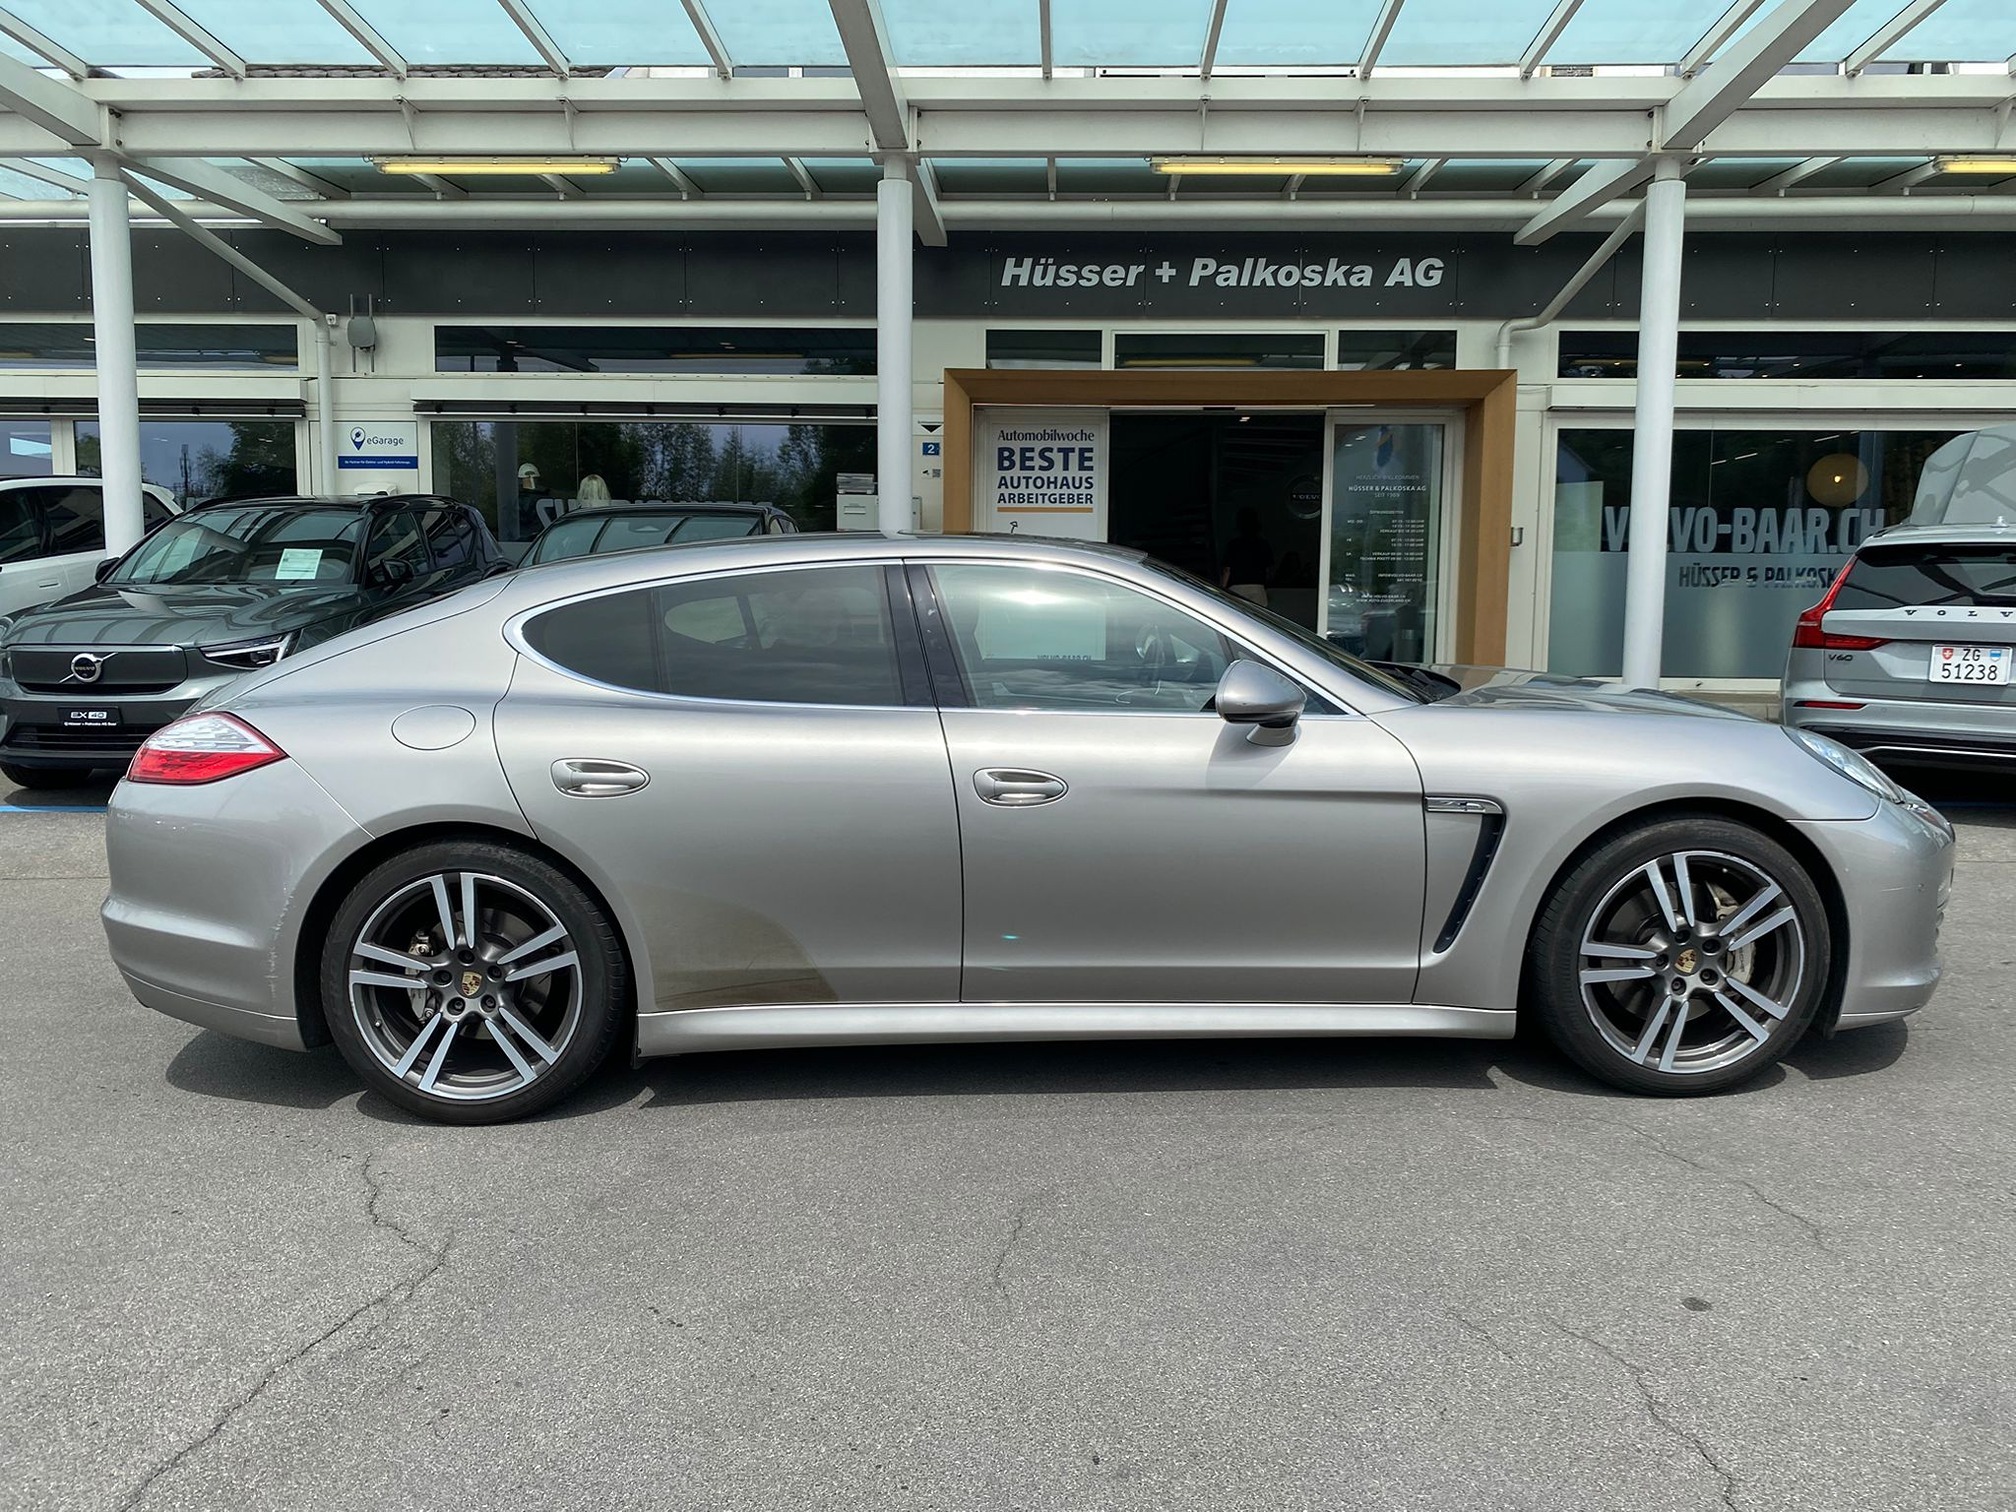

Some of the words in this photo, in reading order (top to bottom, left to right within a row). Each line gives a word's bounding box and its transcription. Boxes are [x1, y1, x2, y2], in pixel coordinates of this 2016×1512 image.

[1000, 257, 1145, 288] Hüsser
[1154, 261, 1177, 284] +
[1188, 257, 1374, 288] Palkoska
[1383, 257, 1445, 288] AG
[366, 436, 404, 447] eGarage
[998, 429, 1095, 441] Automobilwoche
[927, 444, 935, 454] 2
[997, 447, 1094, 471] BESTE
[997, 476, 1094, 489] AUTOHAUS
[997, 493, 1094, 504] ARBEITGEBER
[1604, 506, 1885, 554] VVO-BAAR.CH
[1764, 566, 1842, 589] PALKOSK
[1828, 654, 1854, 662] V60
[1962, 649, 1981, 662] ZG
[1941, 663, 1998, 681] 51238
